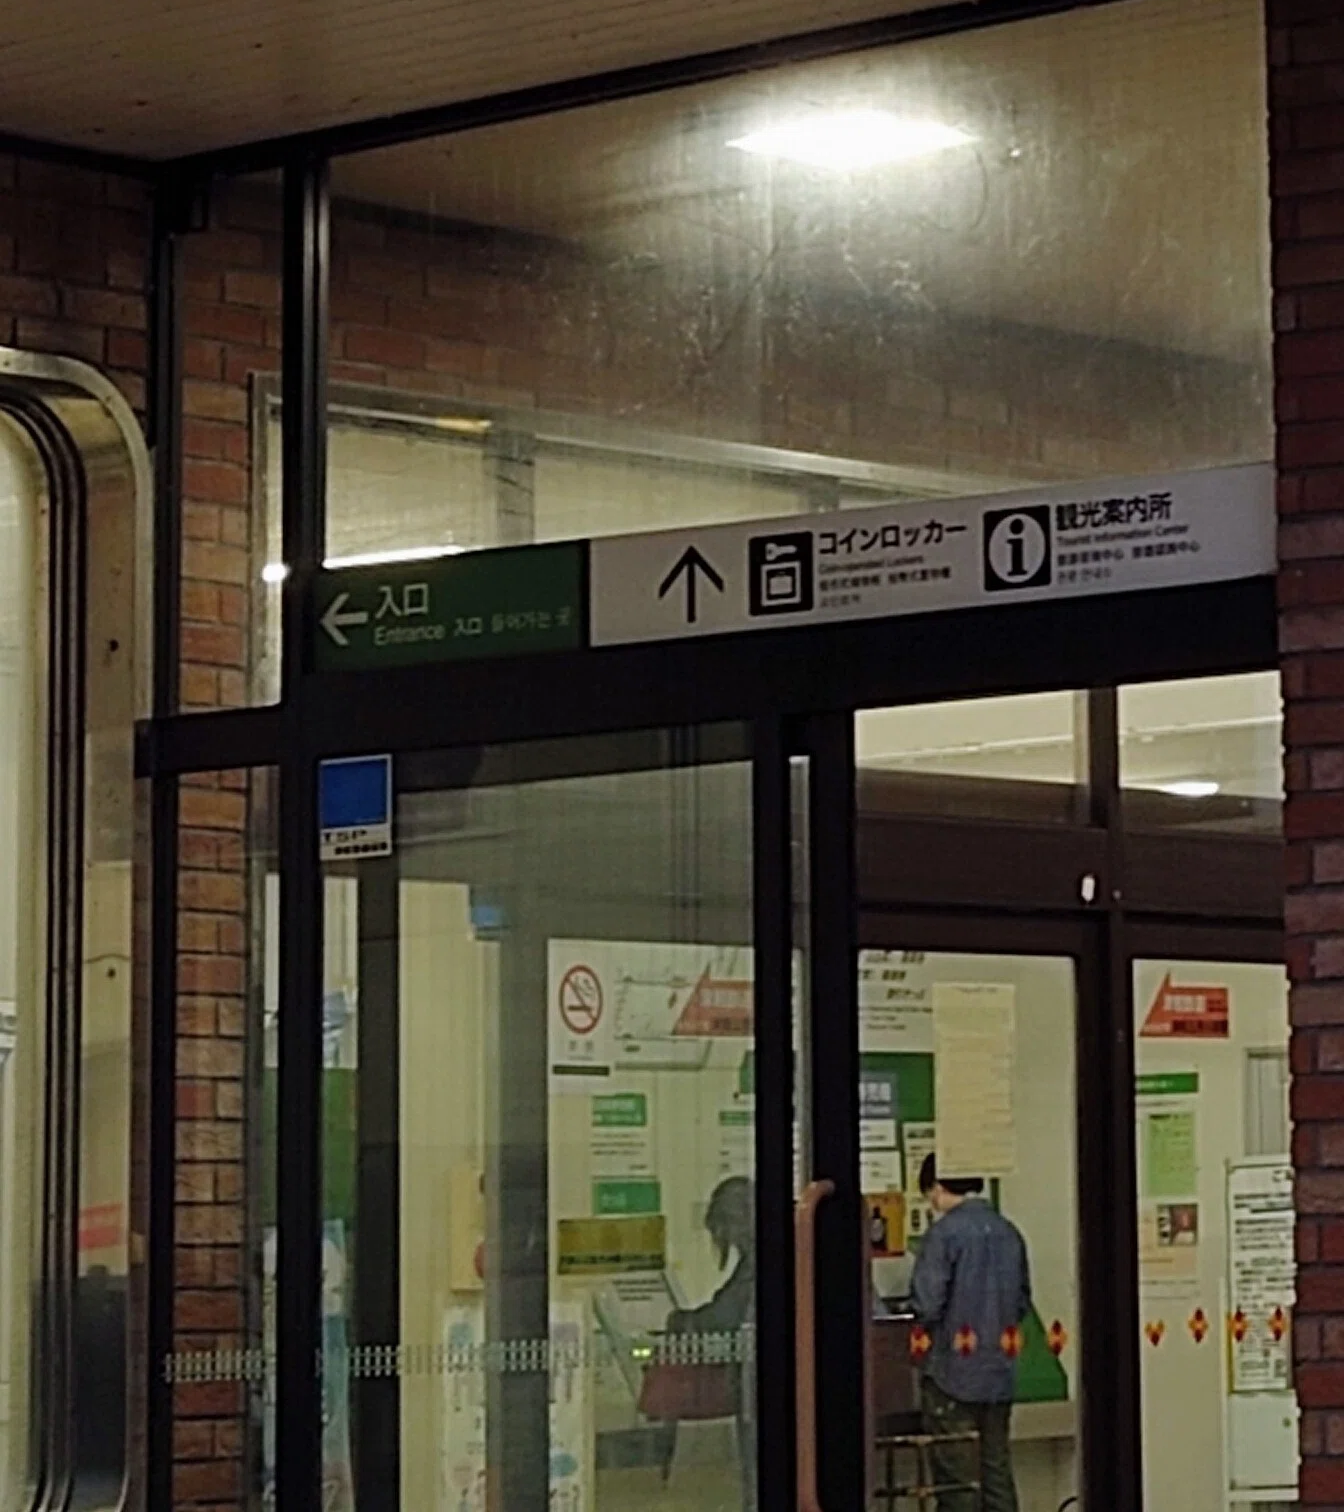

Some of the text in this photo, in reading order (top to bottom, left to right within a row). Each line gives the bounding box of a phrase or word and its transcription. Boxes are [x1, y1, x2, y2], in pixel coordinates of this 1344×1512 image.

[1056, 492, 1172, 531] 観光案内所
[819, 520, 967, 555] コインロッカー
[374, 582, 429, 619] 入口
[374, 624, 446, 646] Entrance
